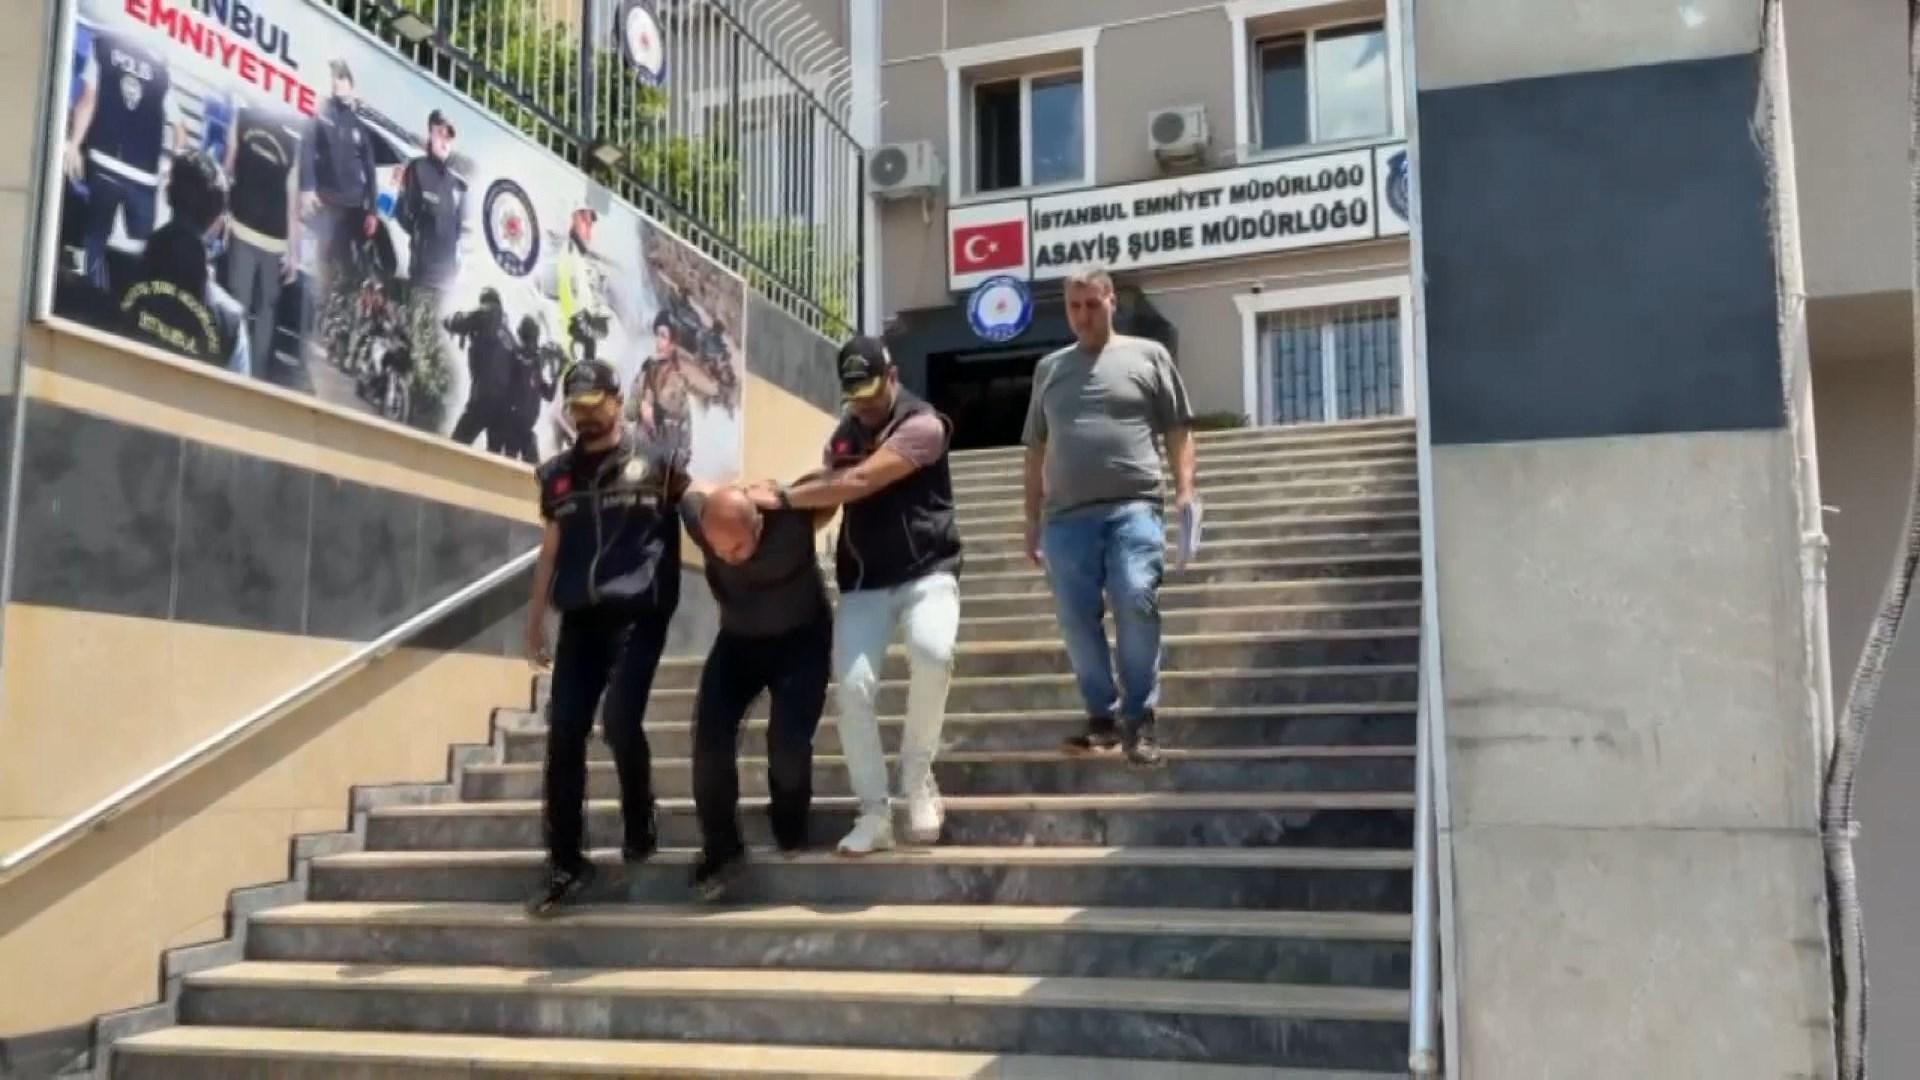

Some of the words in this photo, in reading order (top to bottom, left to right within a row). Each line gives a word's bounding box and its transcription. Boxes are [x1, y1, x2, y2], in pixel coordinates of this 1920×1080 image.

[191, 0, 298, 70] NBUL
[1034, 202, 1128, 231] İSTANBUL
[1133, 187, 1223, 217] EMNİYET
[1229, 164, 1364, 205] MÜDÜRLÜĞÜ
[1036, 232, 1121, 268] ASAYİŞ
[1127, 226, 1195, 263] ŞUBE
[1201, 197, 1368, 246] MÜDÜRLÜĞÜ
